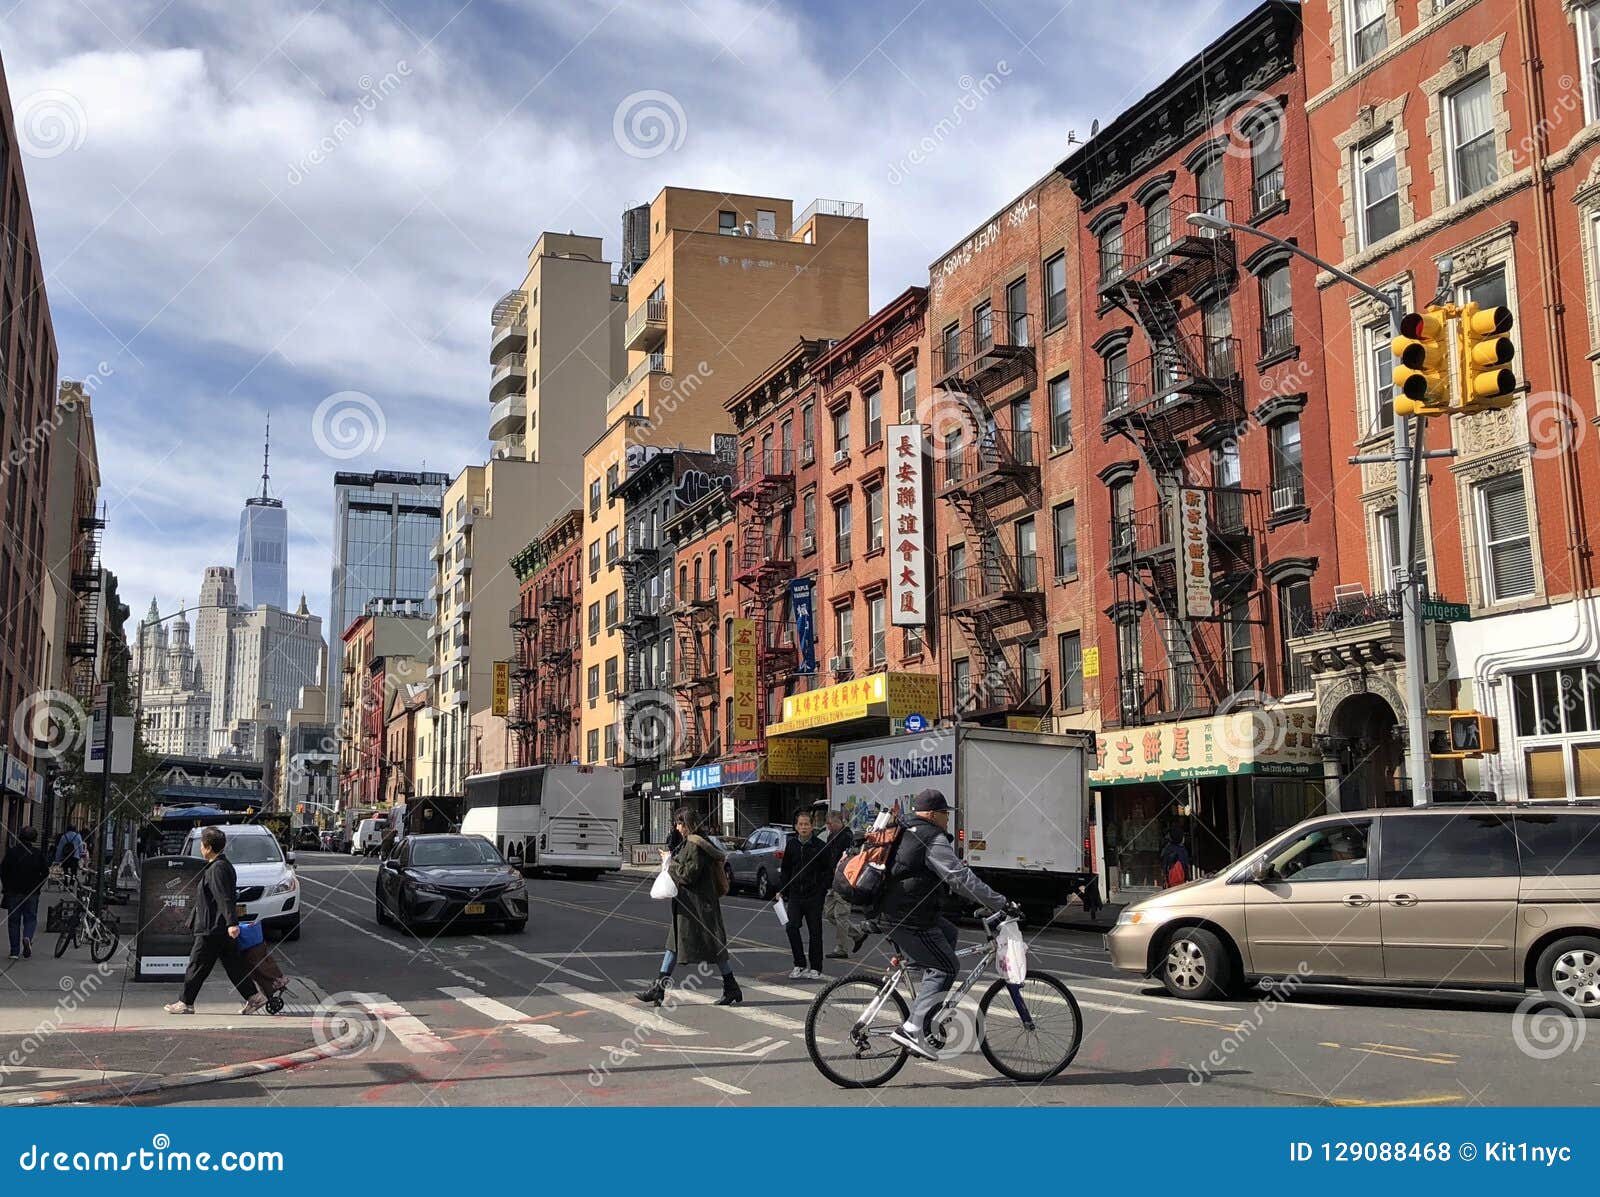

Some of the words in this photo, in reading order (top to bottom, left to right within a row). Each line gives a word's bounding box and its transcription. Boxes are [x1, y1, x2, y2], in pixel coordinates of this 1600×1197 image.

[895, 435, 920, 615] 長安聯誼會大廈
[1421, 603, 1459, 619] Rutgers
[836, 761, 856, 785] 福星
[860, 754, 885, 784] 99¢
[889, 753, 953, 780] WHOLESALES
